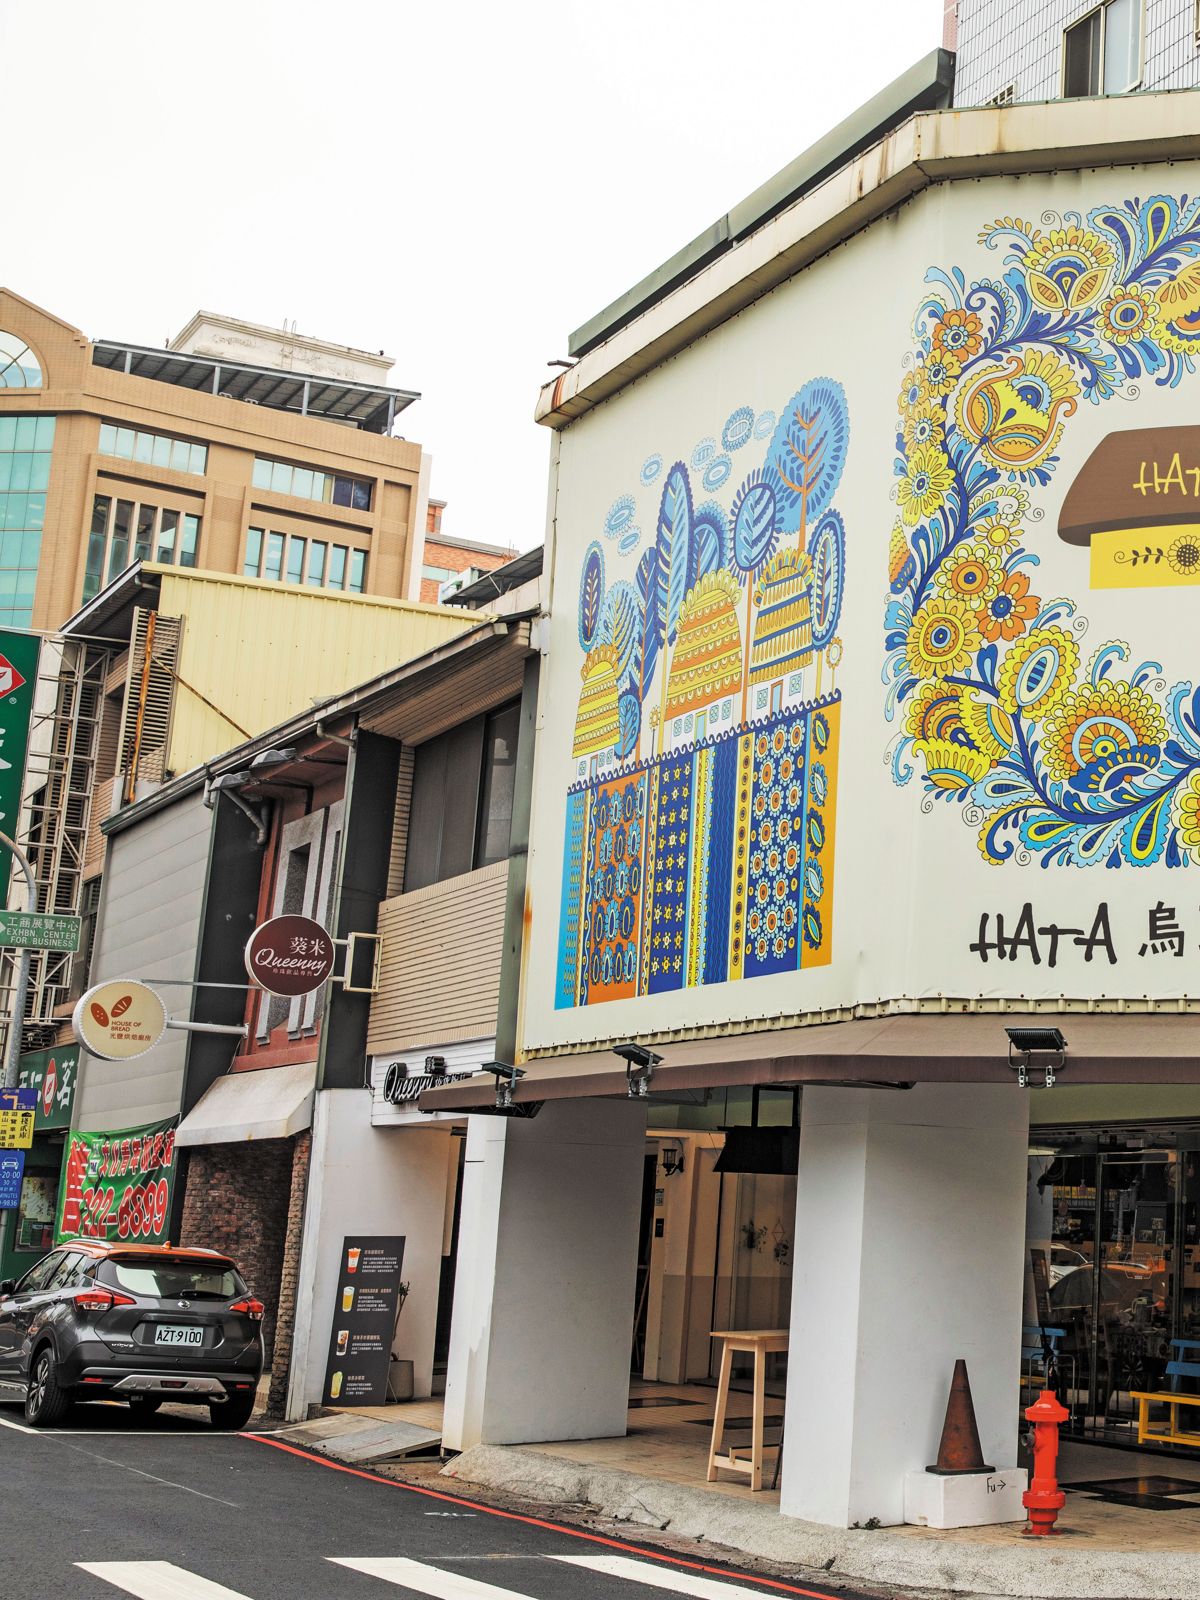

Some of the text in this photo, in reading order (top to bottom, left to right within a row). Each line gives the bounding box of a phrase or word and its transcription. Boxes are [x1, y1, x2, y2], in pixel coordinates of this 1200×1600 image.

[7, 916, 79, 932] 工商展覽中心
[10, 935, 74, 948] FOR BUSINESS
[43, 930, 77, 940] CENTER
[289, 936, 327, 957] 葵米
[254, 948, 328, 977] Queenny
